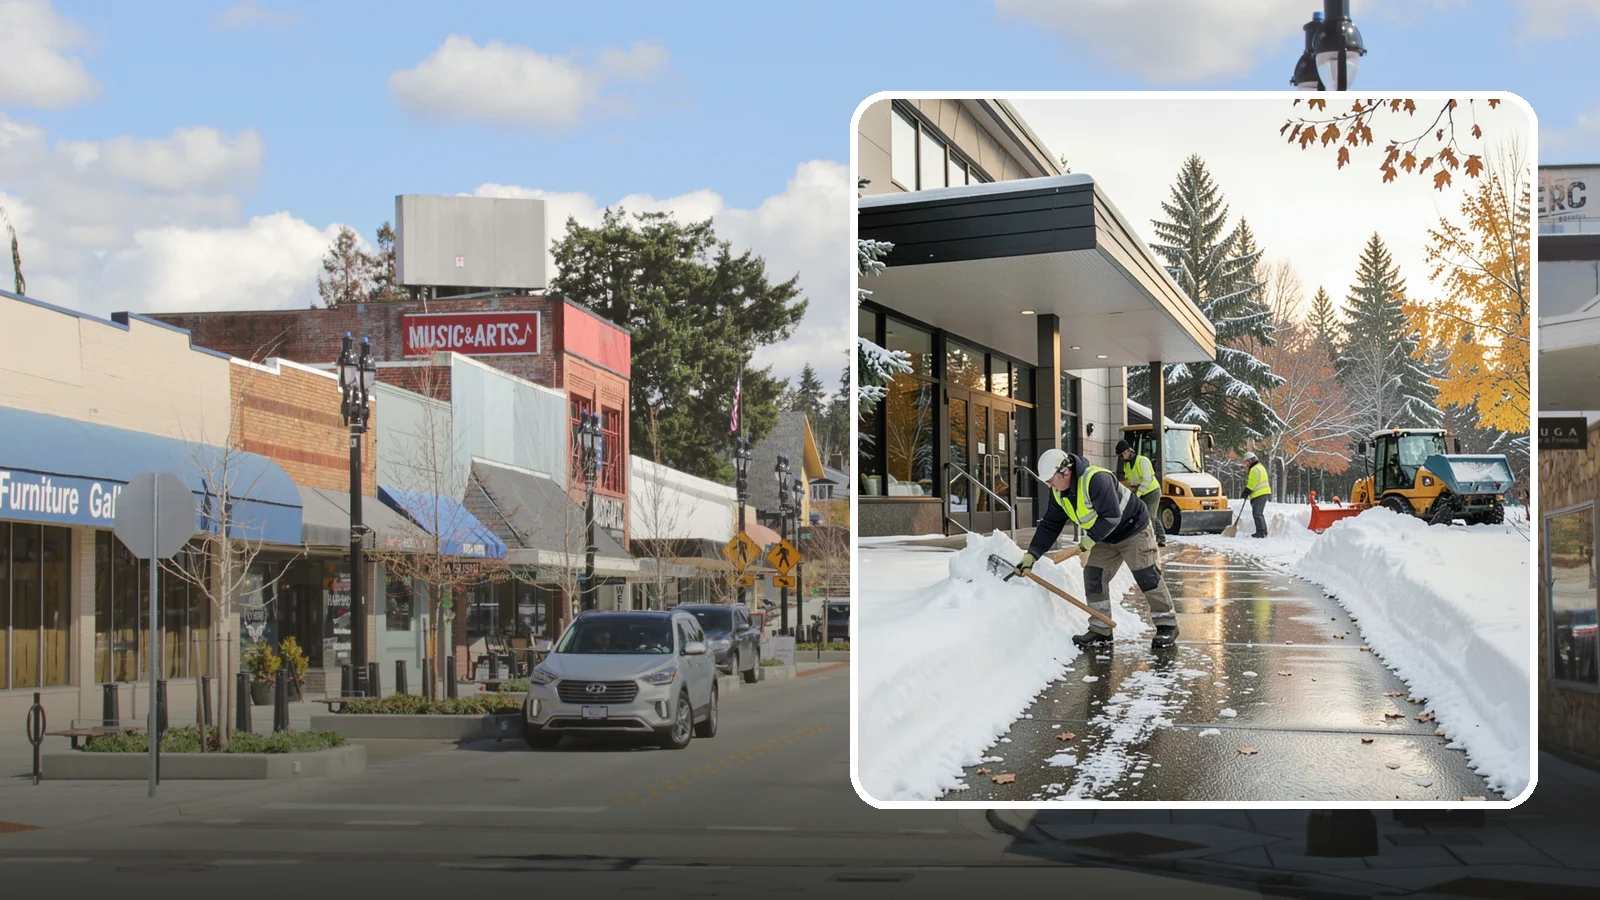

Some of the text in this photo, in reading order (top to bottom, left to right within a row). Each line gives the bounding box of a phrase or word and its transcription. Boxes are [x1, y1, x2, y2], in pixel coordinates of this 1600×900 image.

[409, 323, 519, 348] MUSIC&ARTS
[0, 471, 121, 519] Furniture Gal
[453, 563, 479, 574] SUSHI
